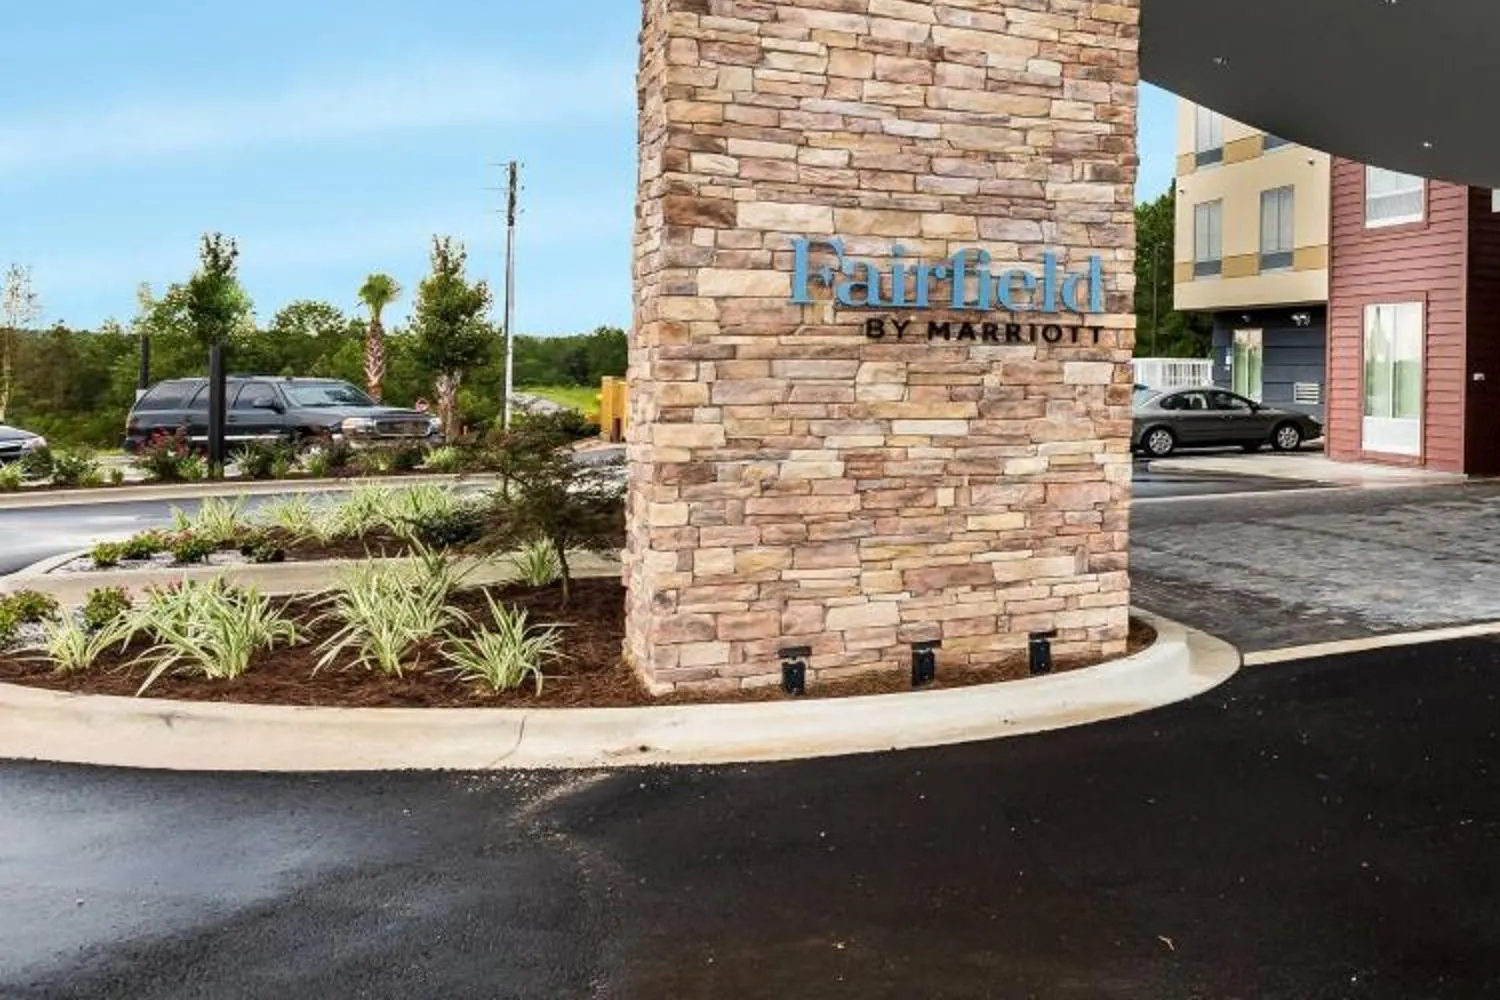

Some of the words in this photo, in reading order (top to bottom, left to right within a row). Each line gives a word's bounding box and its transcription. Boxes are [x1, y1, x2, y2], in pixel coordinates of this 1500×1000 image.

[788, 235, 1106, 313] Fairfield
[865, 317, 912, 340] BY
[927, 320, 1104, 344] MARRIOTT
